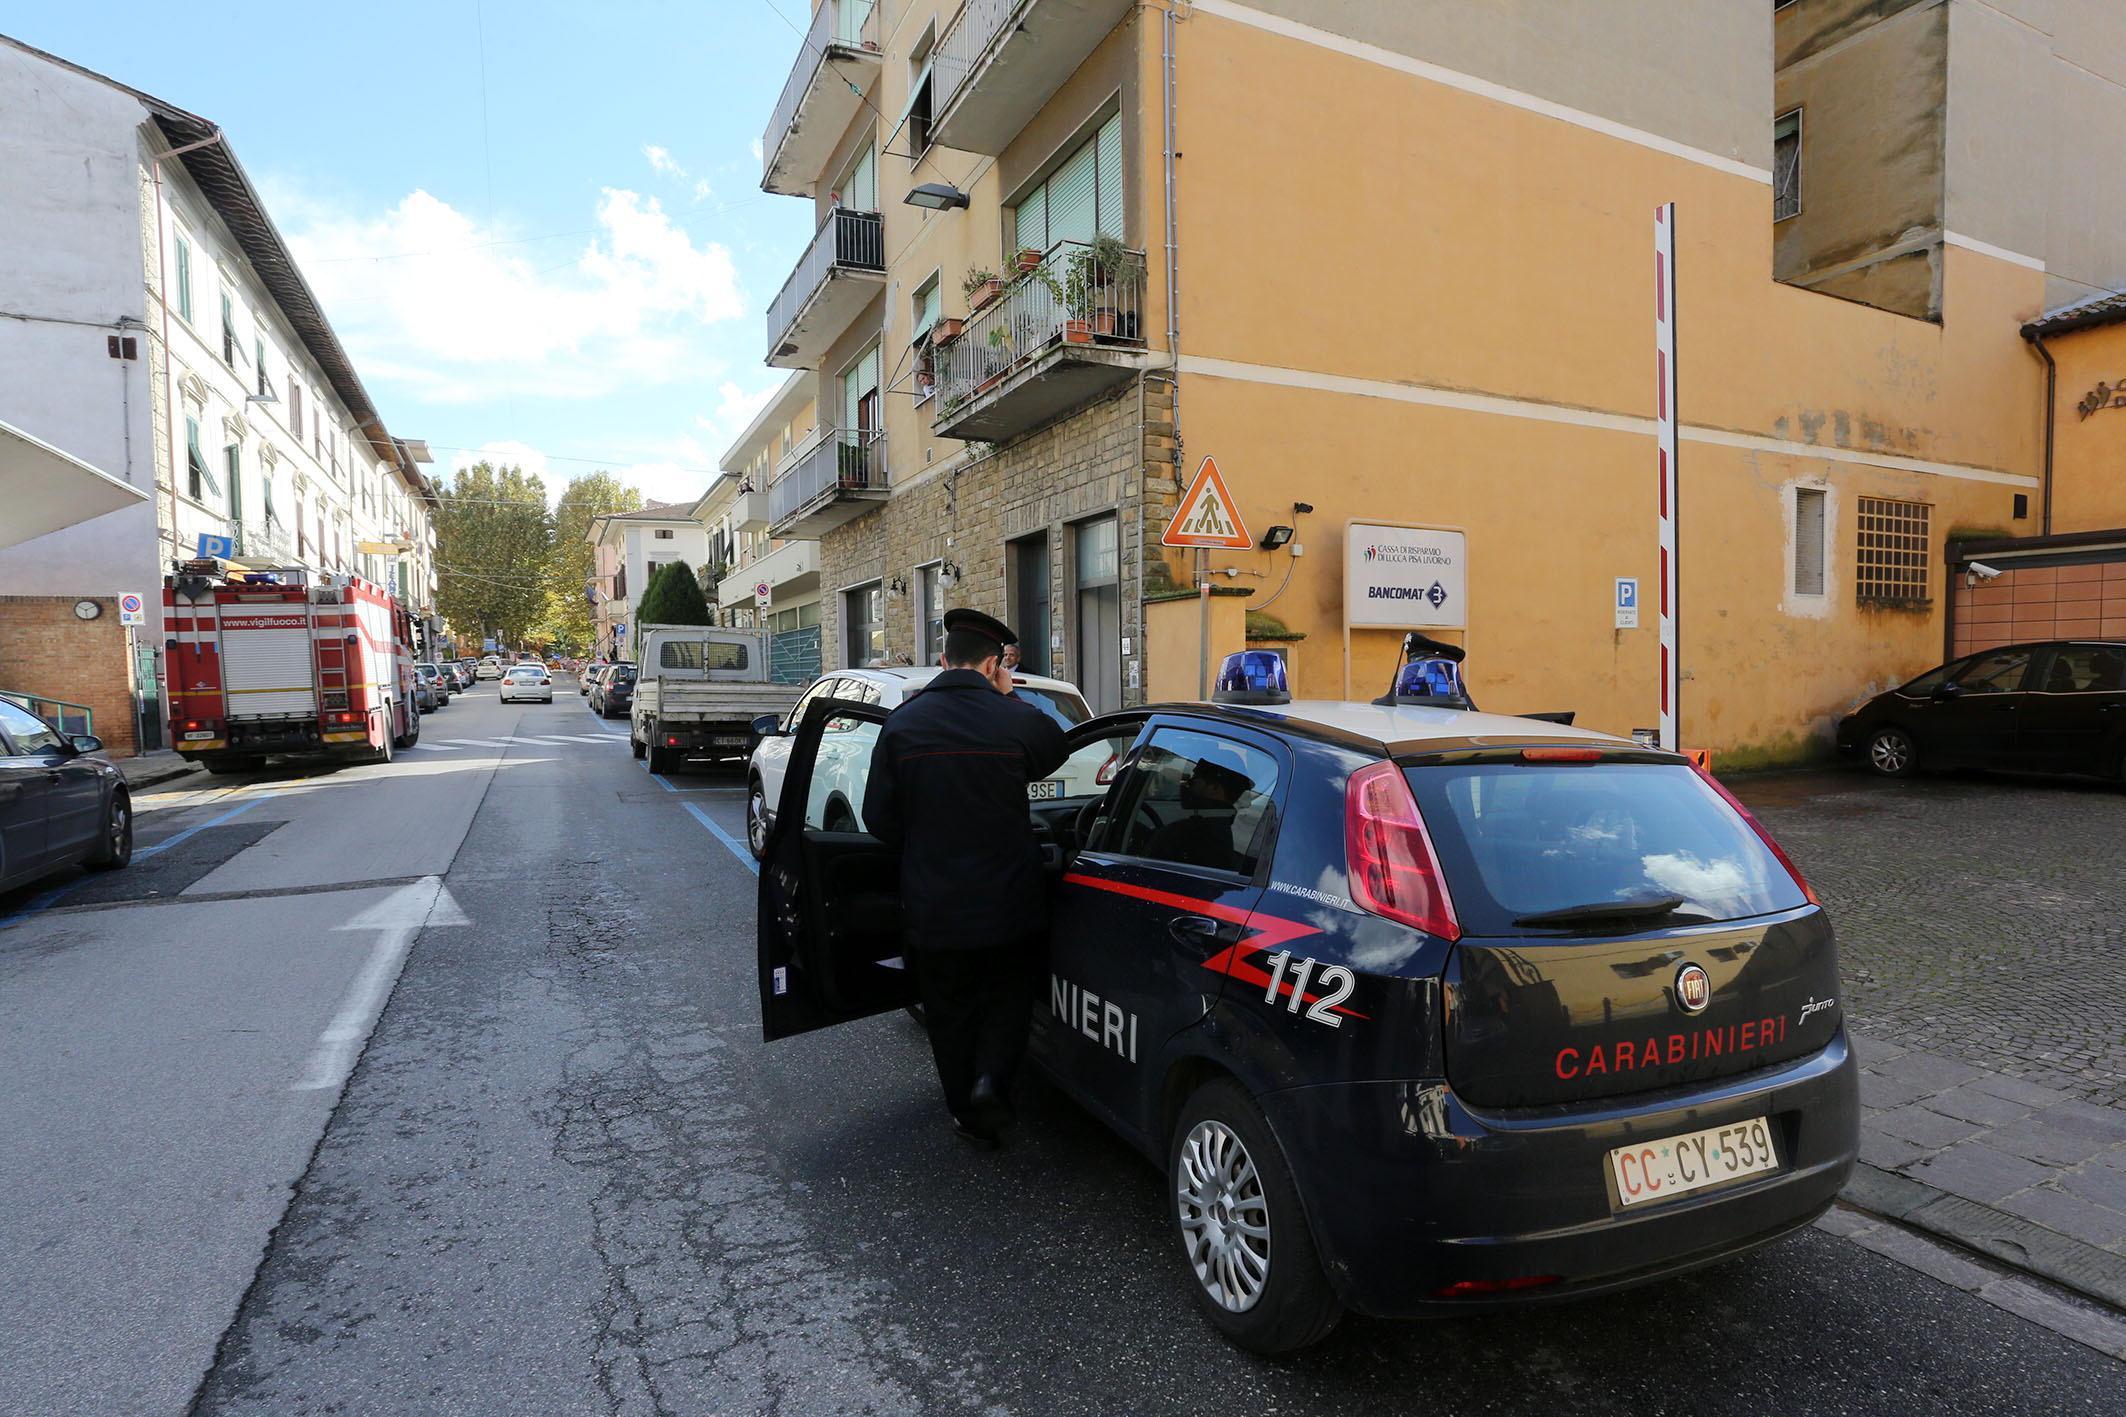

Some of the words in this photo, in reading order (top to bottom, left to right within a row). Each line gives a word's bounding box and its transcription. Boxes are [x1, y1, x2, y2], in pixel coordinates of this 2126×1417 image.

[205, 537, 224, 557] P
[1378, 545, 1399, 554] CASSA
[1400, 546, 1408, 554] DI
[1408, 546, 1441, 556] RISPARMIO
[1378, 553, 1385, 562] DI
[1386, 554, 1408, 563] LUCCA
[1408, 555, 1422, 564] PISA
[1423, 556, 1451, 566] LIVORNO
[1368, 586, 1425, 600] BANCOMAT
[1621, 584, 1633, 605] P
[223, 617, 306, 628] www.vigilfuoco.it
[1271, 881, 1349, 908] WWW.CARABINIERI.IT
[1265, 950, 1355, 1028] 112
[1687, 979, 1704, 1000] FIAT
[1052, 973, 1137, 1064] NIERI
[1555, 1015, 1787, 1080] CARABINIERI
[1620, 1149, 1661, 1196] CC
[1675, 1136, 1711, 1183] CY
[1718, 1123, 1770, 1172] 539
